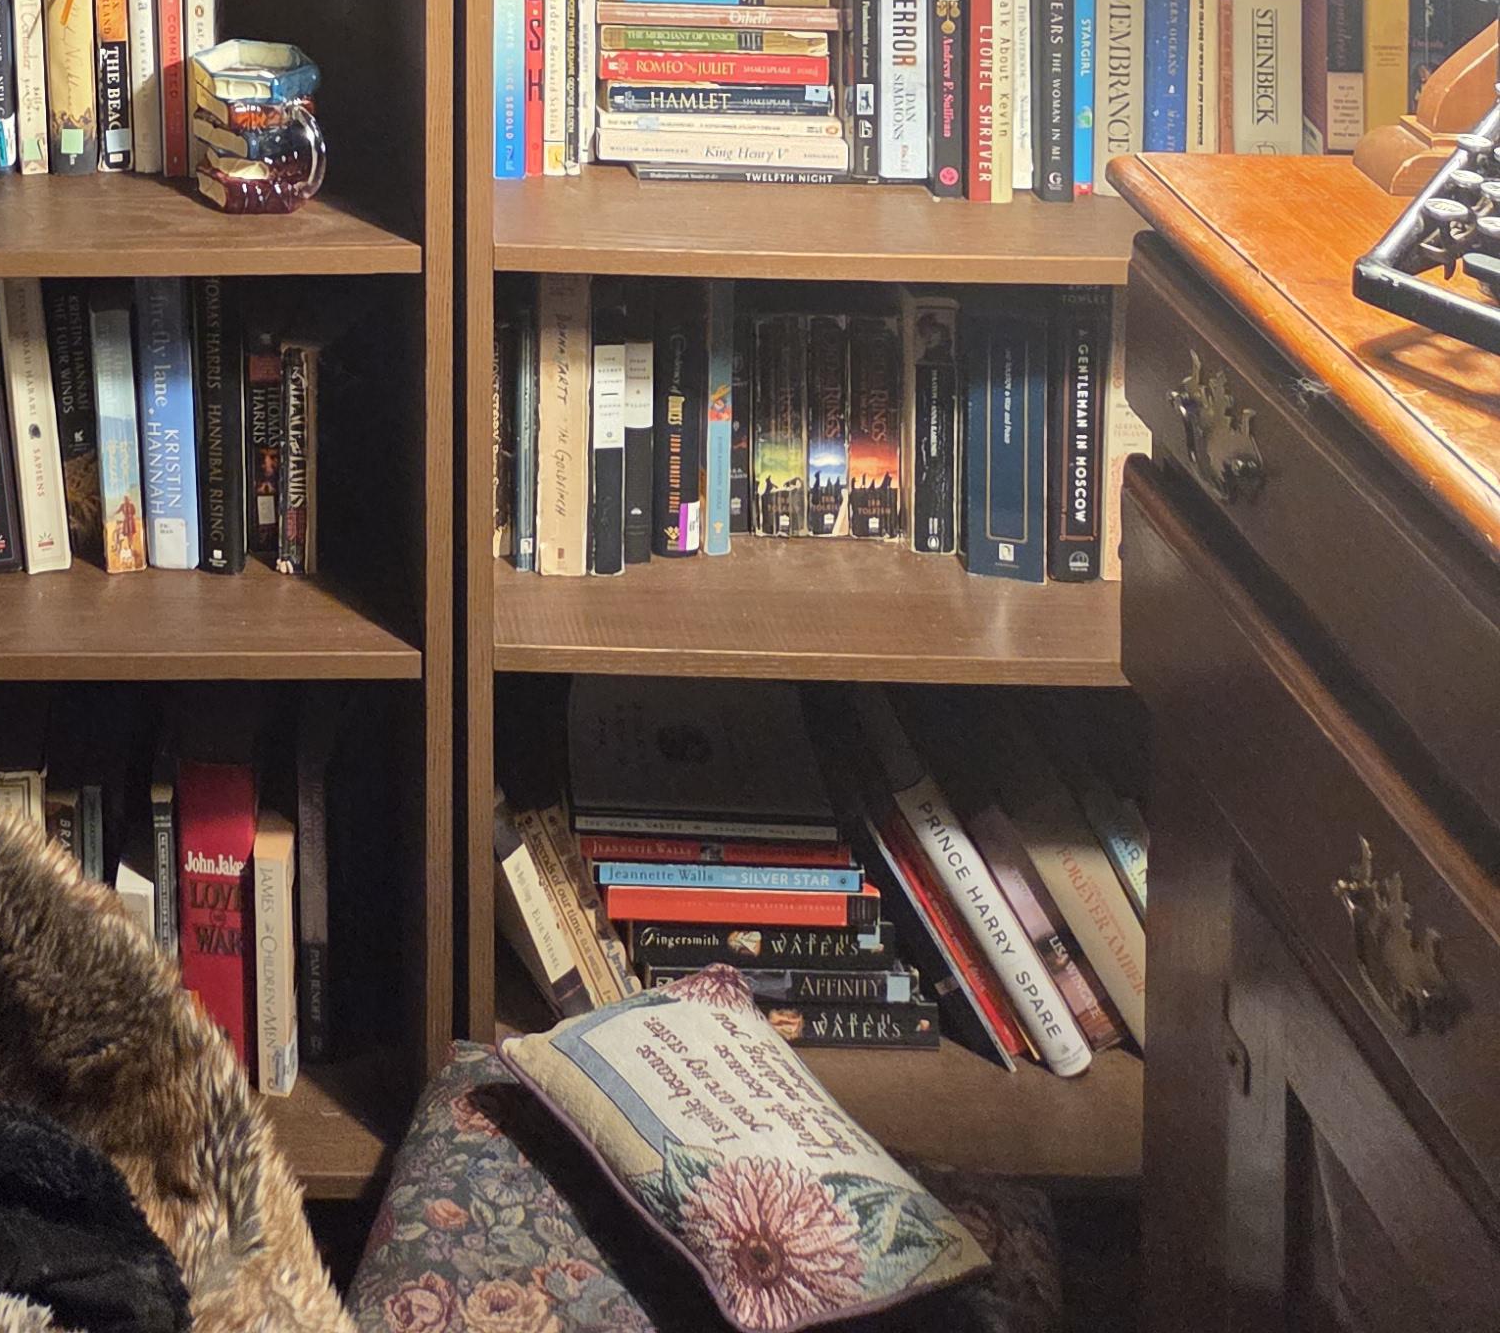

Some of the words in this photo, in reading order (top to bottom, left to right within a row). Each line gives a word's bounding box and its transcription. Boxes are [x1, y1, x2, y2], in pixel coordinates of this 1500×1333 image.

[636, 60, 685, 76] ROMEO
[697, 60, 736, 76] JULIET
[979, 26, 992, 91] LIONEL
[1080, 19, 1091, 76] STARGIRL
[1256, 8, 1276, 123] STEINBECK
[650, 92, 730, 109] HAMLET
[978, 105, 992, 182] SHRIVER
[148, 421, 164, 515] HANNAH
[164, 430, 180, 509] KRISTIN
[215, 854, 244, 876] Jake
[917, 801, 969, 882] PRINCE
[967, 889, 1013, 957] HARRY
[1015, 971, 1061, 1040] SPARE
[801, 975, 882, 998] AFFINITY
